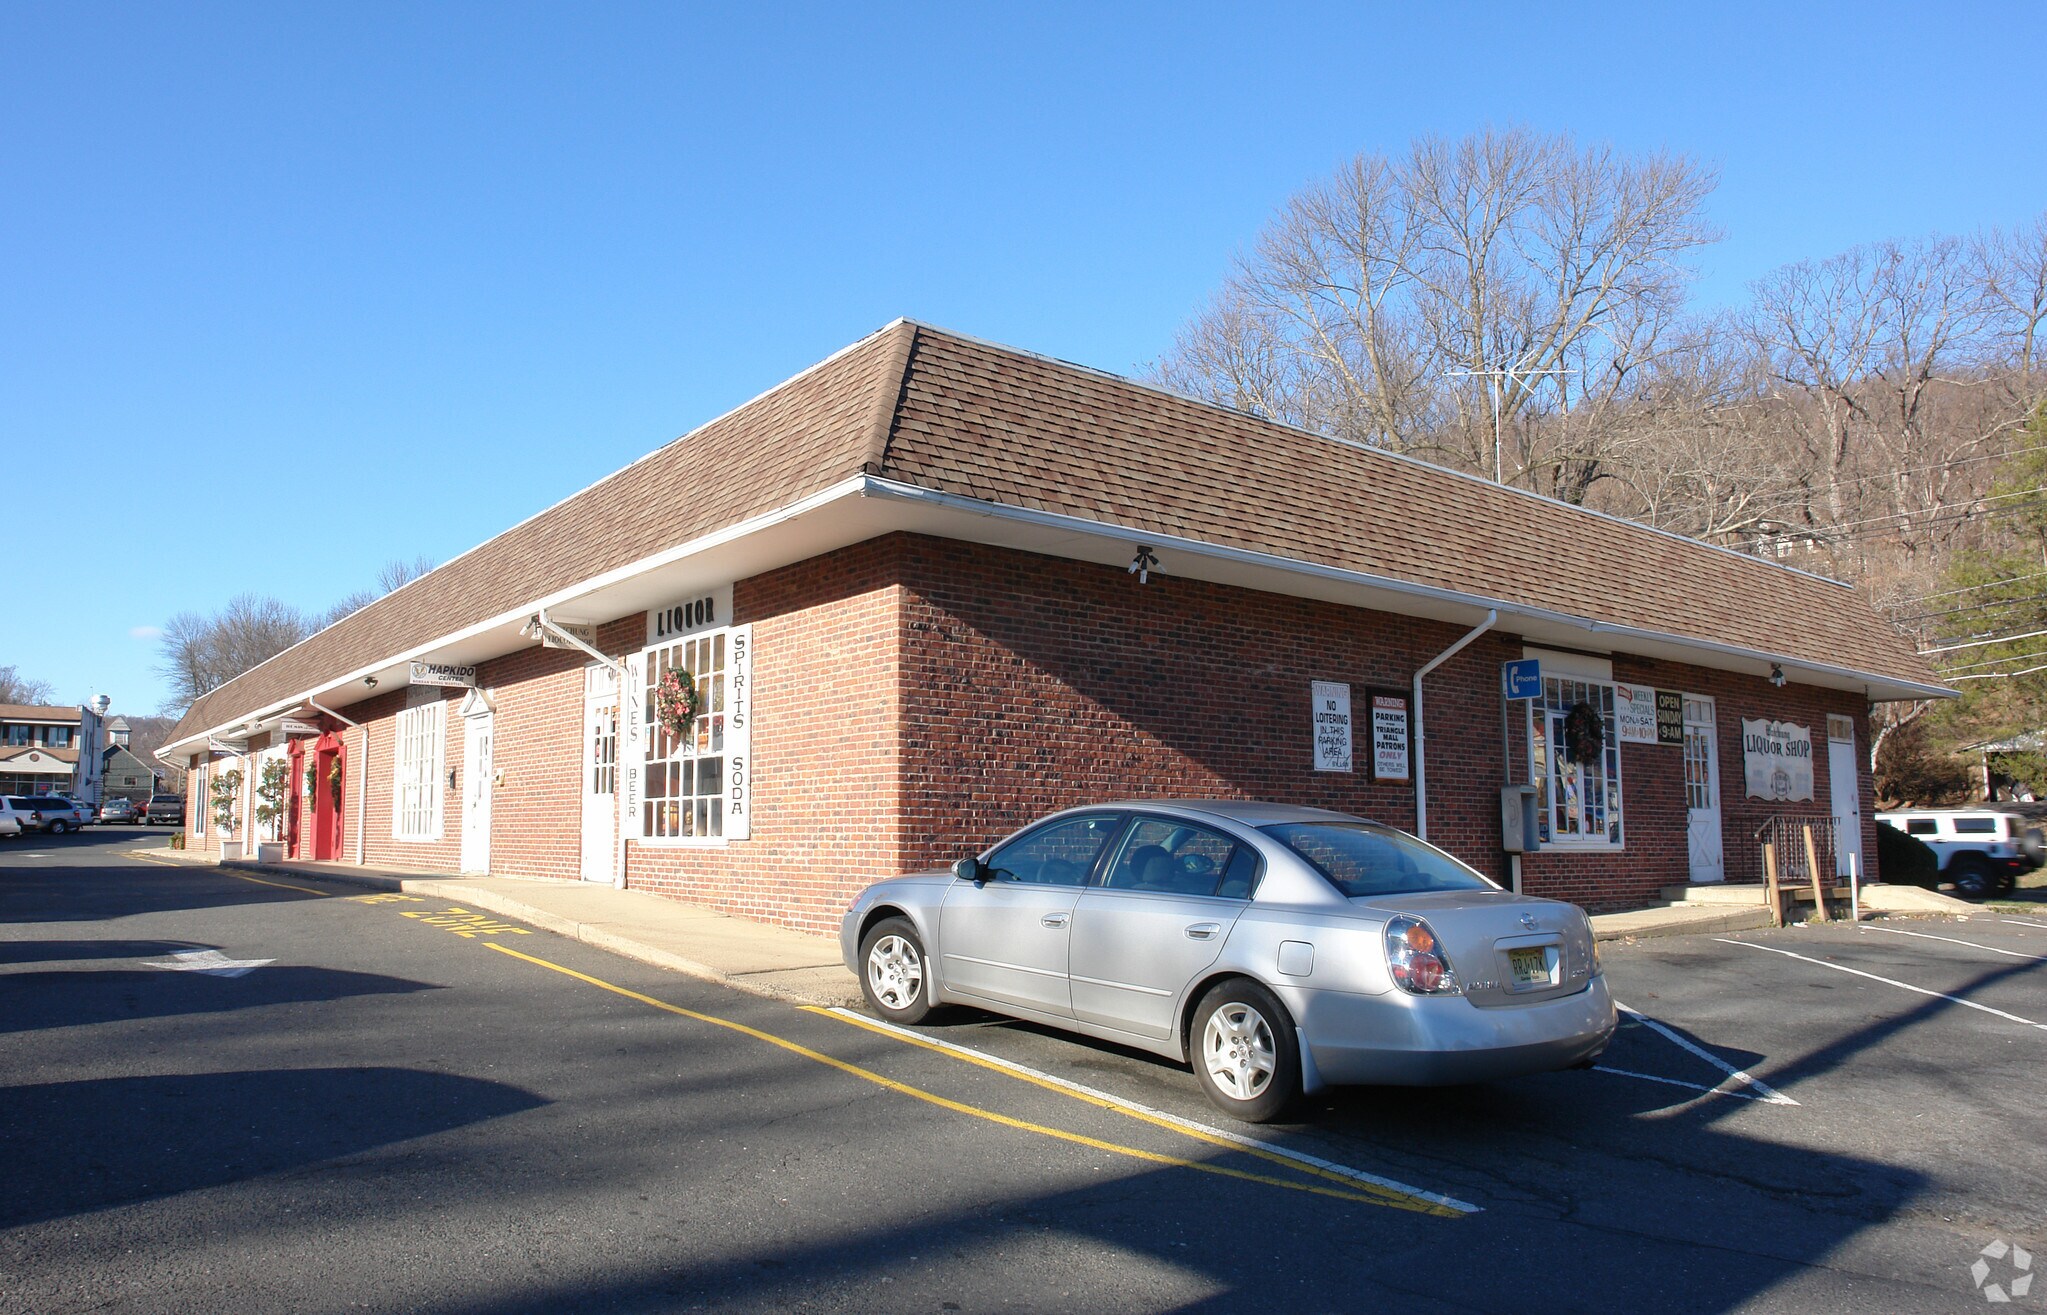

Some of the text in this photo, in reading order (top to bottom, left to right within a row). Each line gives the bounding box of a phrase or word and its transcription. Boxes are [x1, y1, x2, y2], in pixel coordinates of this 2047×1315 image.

[657, 596, 714, 637] LIQUOR
[427, 663, 475, 677] HAPKIDO
[438, 674, 464, 682] CENTER
[1516, 675, 1538, 683] Phone
[1633, 690, 1652, 702] WEEKLY
[1658, 695, 1680, 709] OPEN
[1326, 700, 1337, 711] NO
[1315, 712, 1349, 726] LOITERING
[1375, 712, 1405, 722] PARKING
[1657, 709, 1682, 725] SUNDAY
[731, 634, 745, 815] SPIRITS SODA
[1376, 726, 1405, 735] TRIANGLE
[1329, 726, 1345, 736] THIS
[1318, 735, 1347, 746] PARKING
[1376, 741, 1405, 751] PATRONS
[1745, 734, 1810, 758] LIQUOR SHOP
[1379, 750, 1404, 760] ONLY
[628, 768, 637, 818] BEER
[398, 907, 534, 939] ZONE
